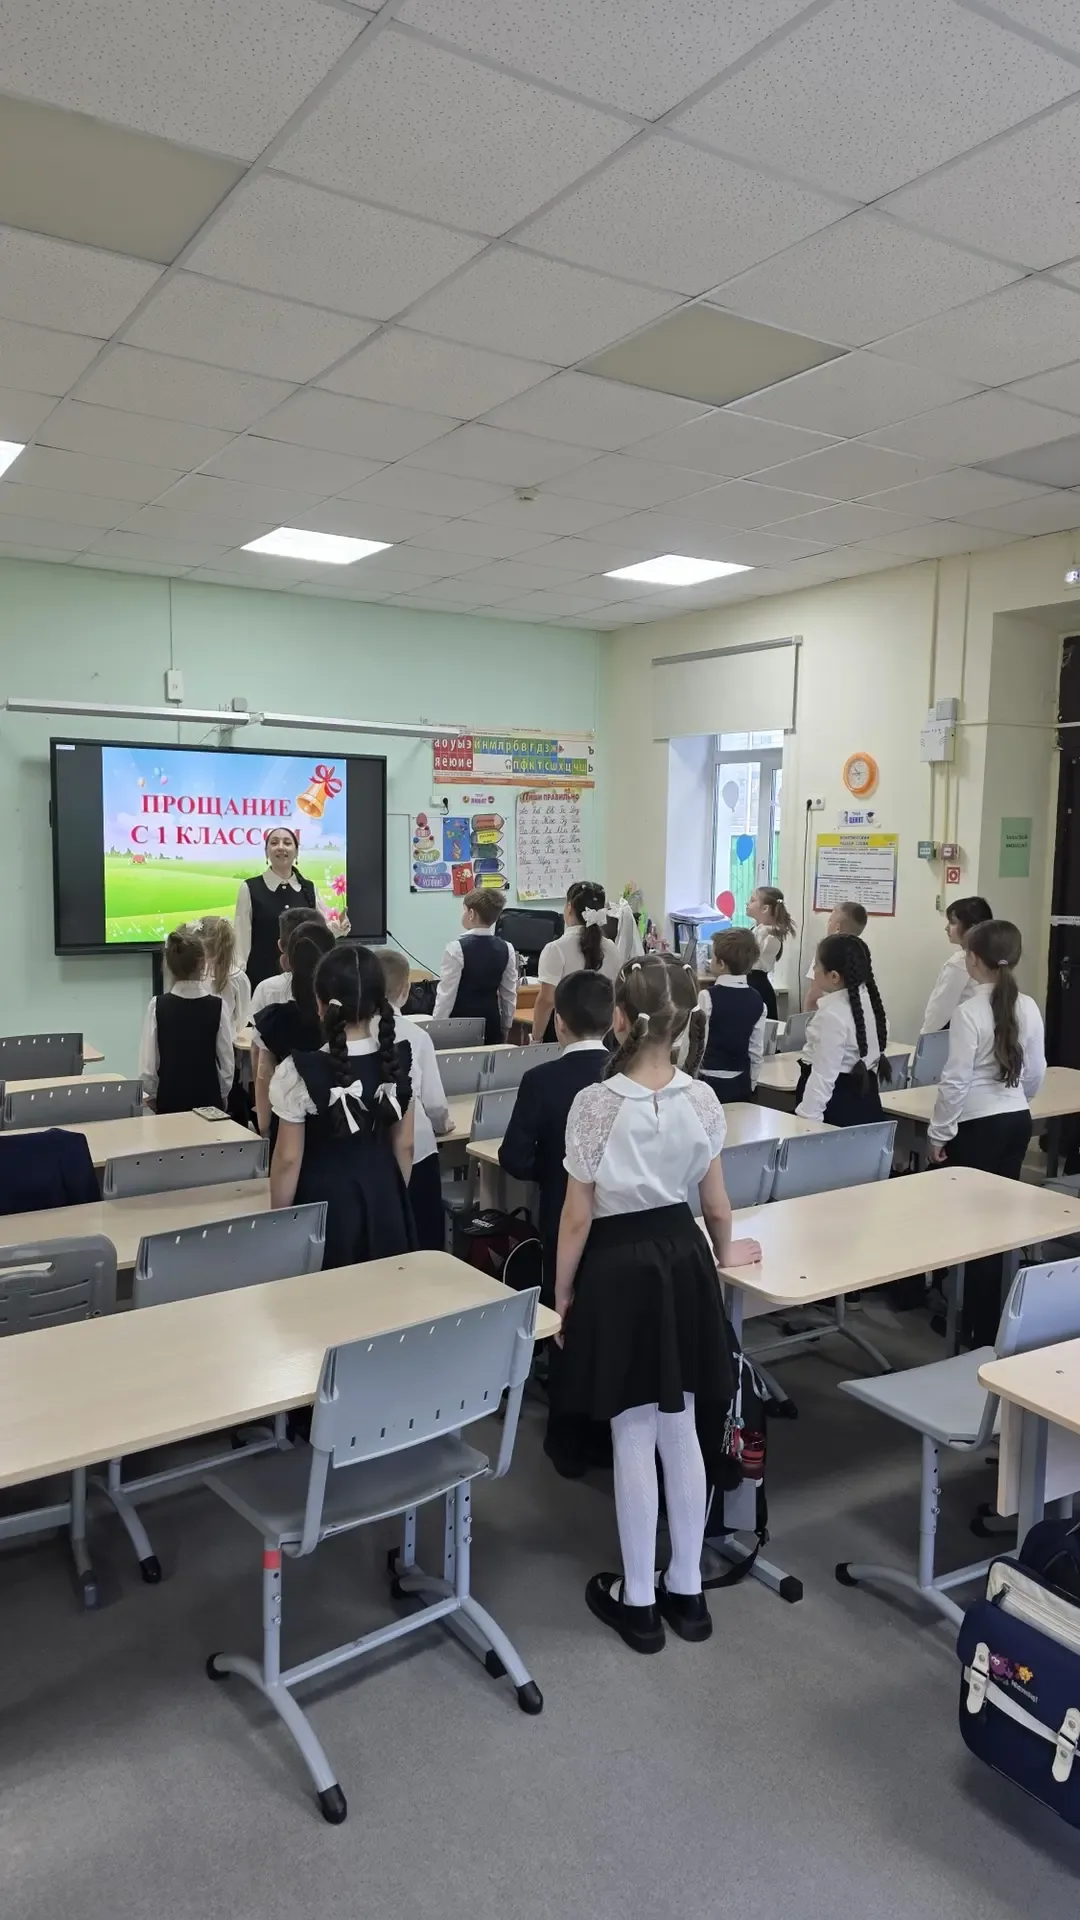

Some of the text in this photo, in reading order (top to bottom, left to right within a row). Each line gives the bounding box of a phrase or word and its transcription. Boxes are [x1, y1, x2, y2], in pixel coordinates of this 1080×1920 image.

[142, 794, 292, 819] ПРОЩАНИЕ
[131, 825, 302, 846] С 1 КЛАСС
